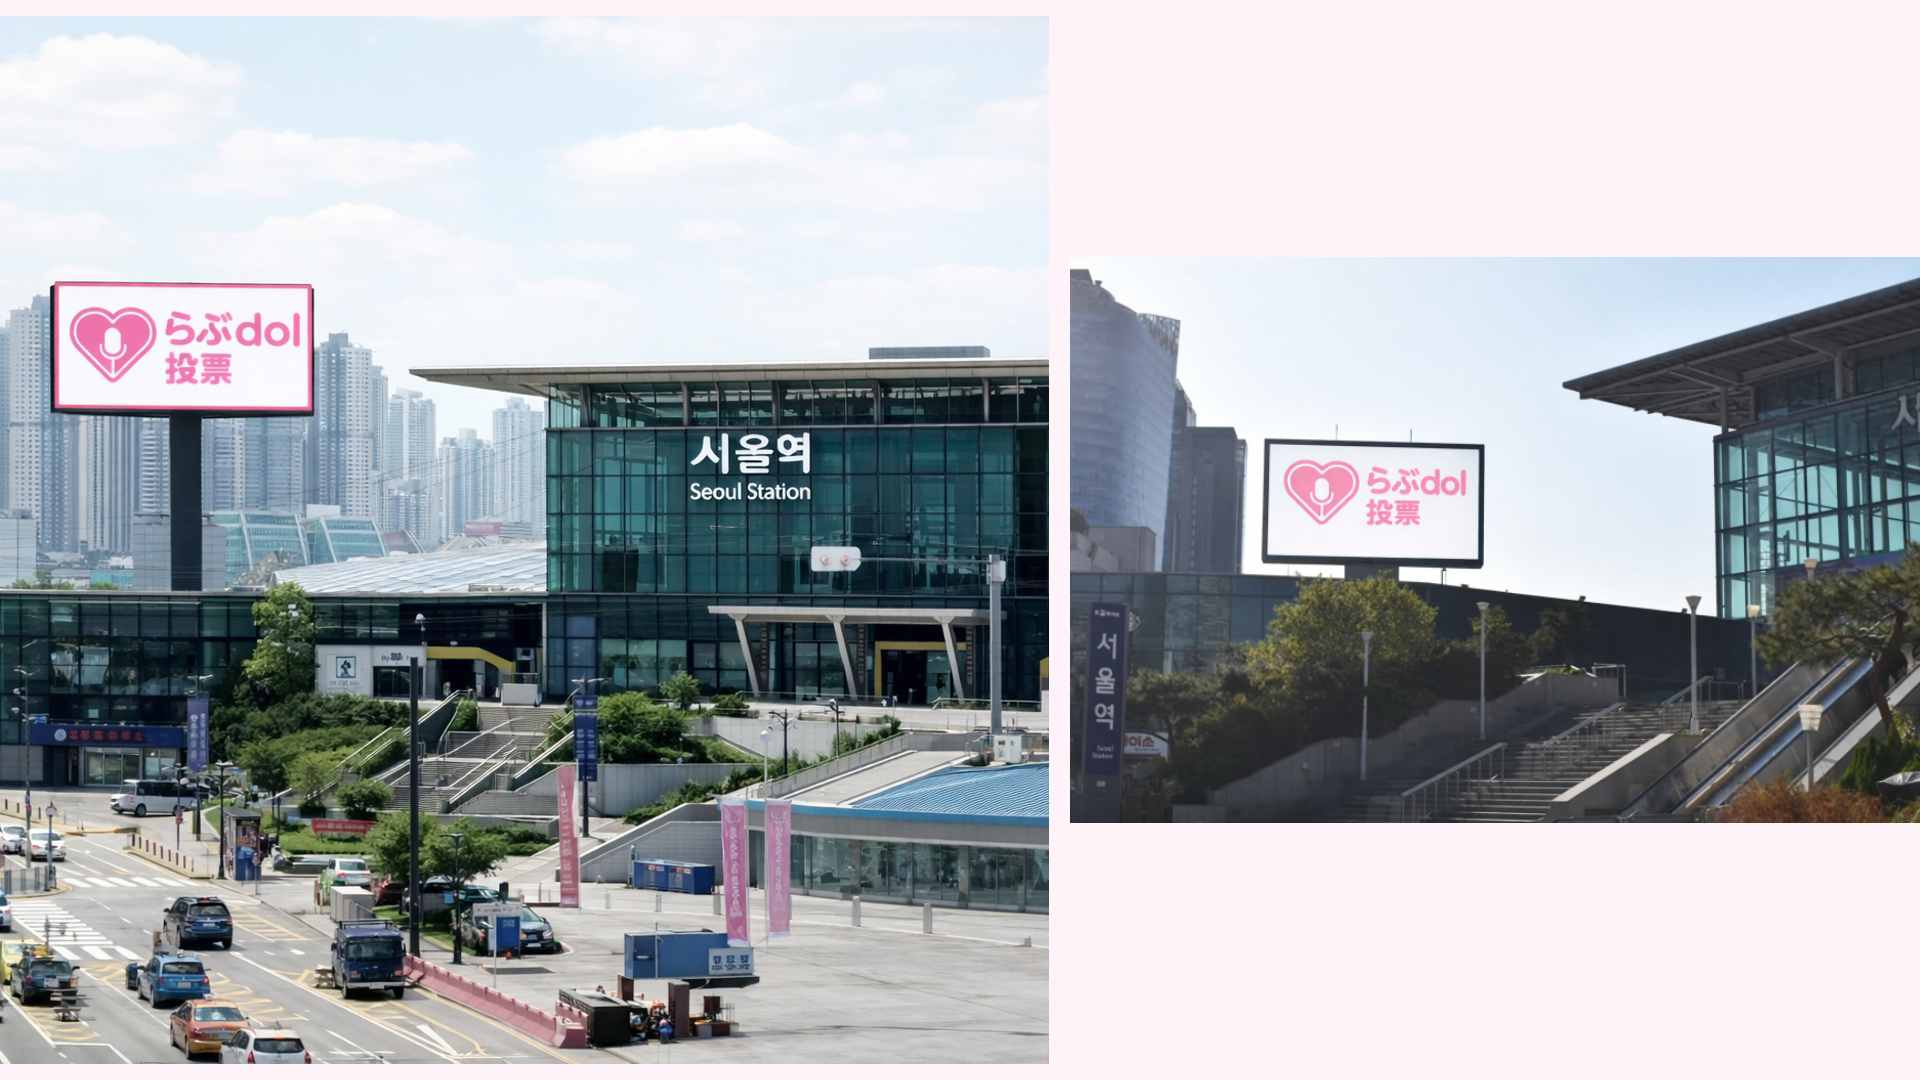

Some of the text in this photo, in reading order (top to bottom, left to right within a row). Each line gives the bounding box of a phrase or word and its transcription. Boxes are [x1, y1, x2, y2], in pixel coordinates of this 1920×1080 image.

[165, 311, 300, 347] らぶdol
[165, 352, 232, 384] 投票
[690, 482, 811, 500] Seoul Station
[1367, 466, 1467, 496] らぶdol
[1366, 499, 1421, 526] 投票
[1094, 633, 1117, 731] 서울역
